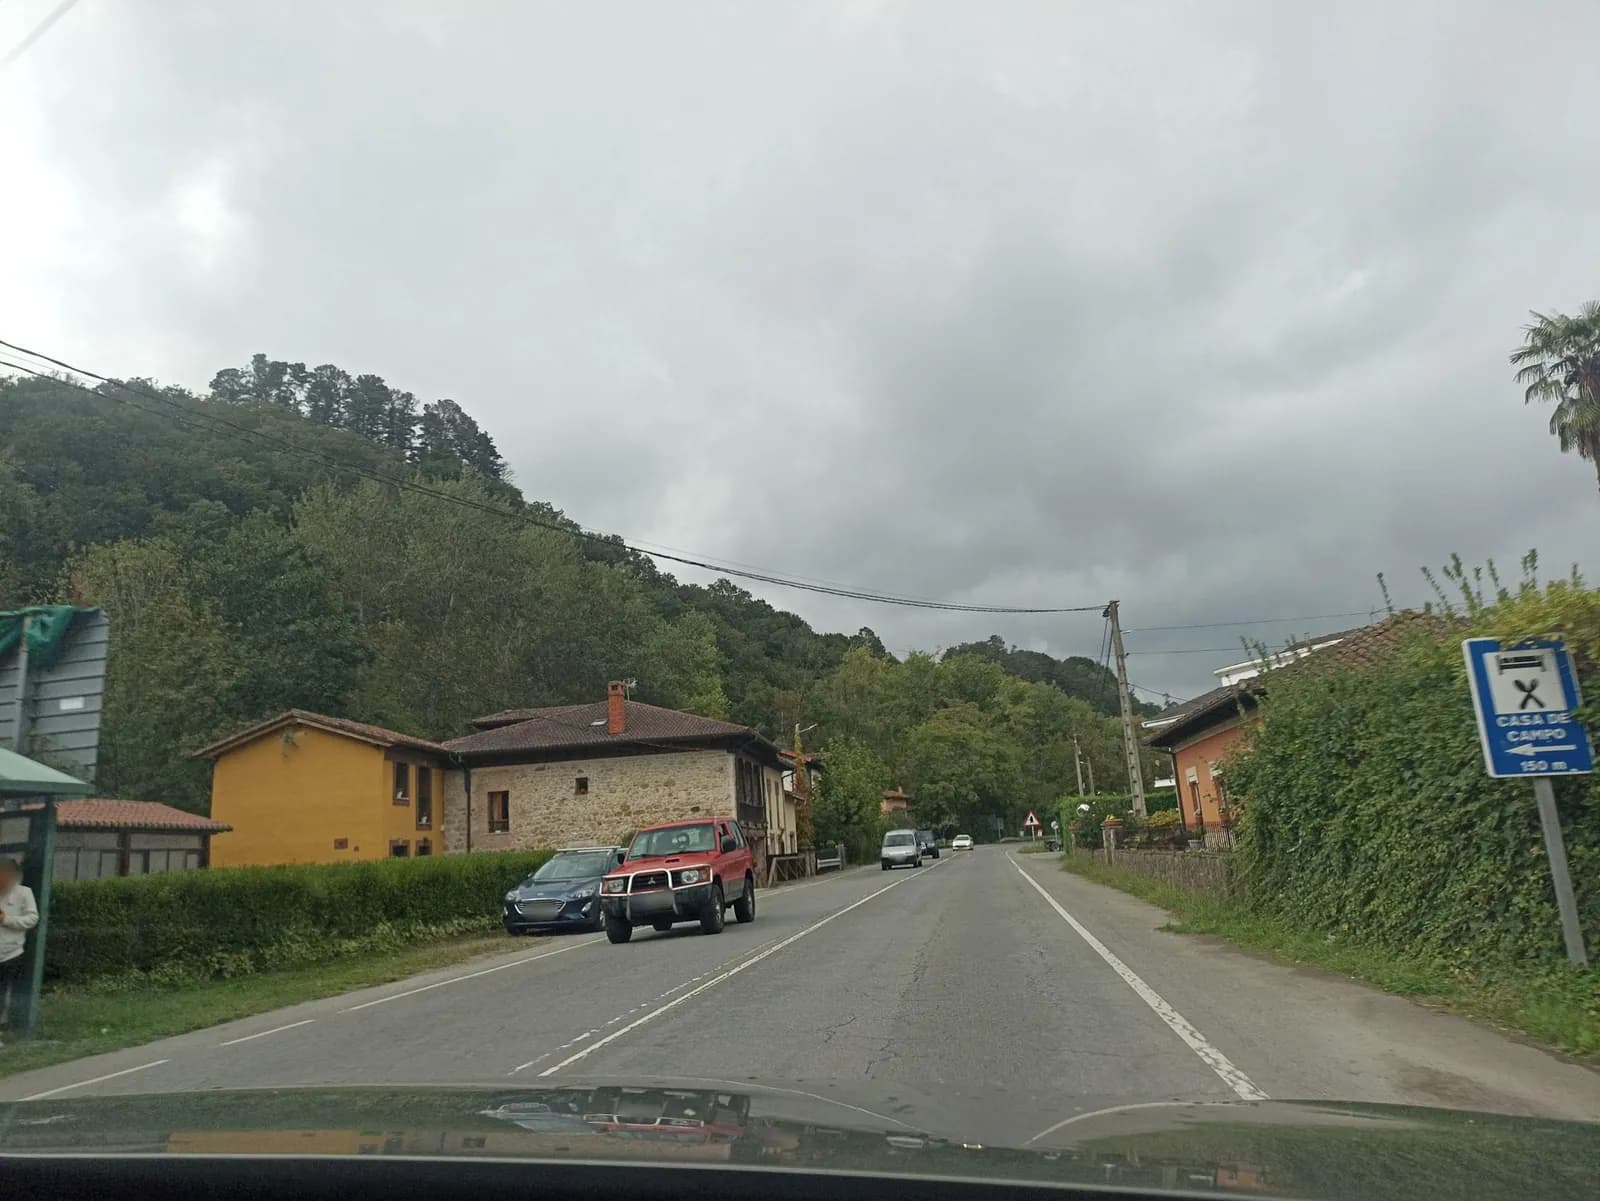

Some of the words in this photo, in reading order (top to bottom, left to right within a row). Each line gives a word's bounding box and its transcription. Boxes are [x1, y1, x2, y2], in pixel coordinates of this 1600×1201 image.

[1496, 714, 1544, 727] CASA
[1547, 712, 1570, 724] DE
[1506, 728, 1566, 741] CAMPO
[1520, 760, 1548, 772] 150
[1551, 761, 1567, 770] m
